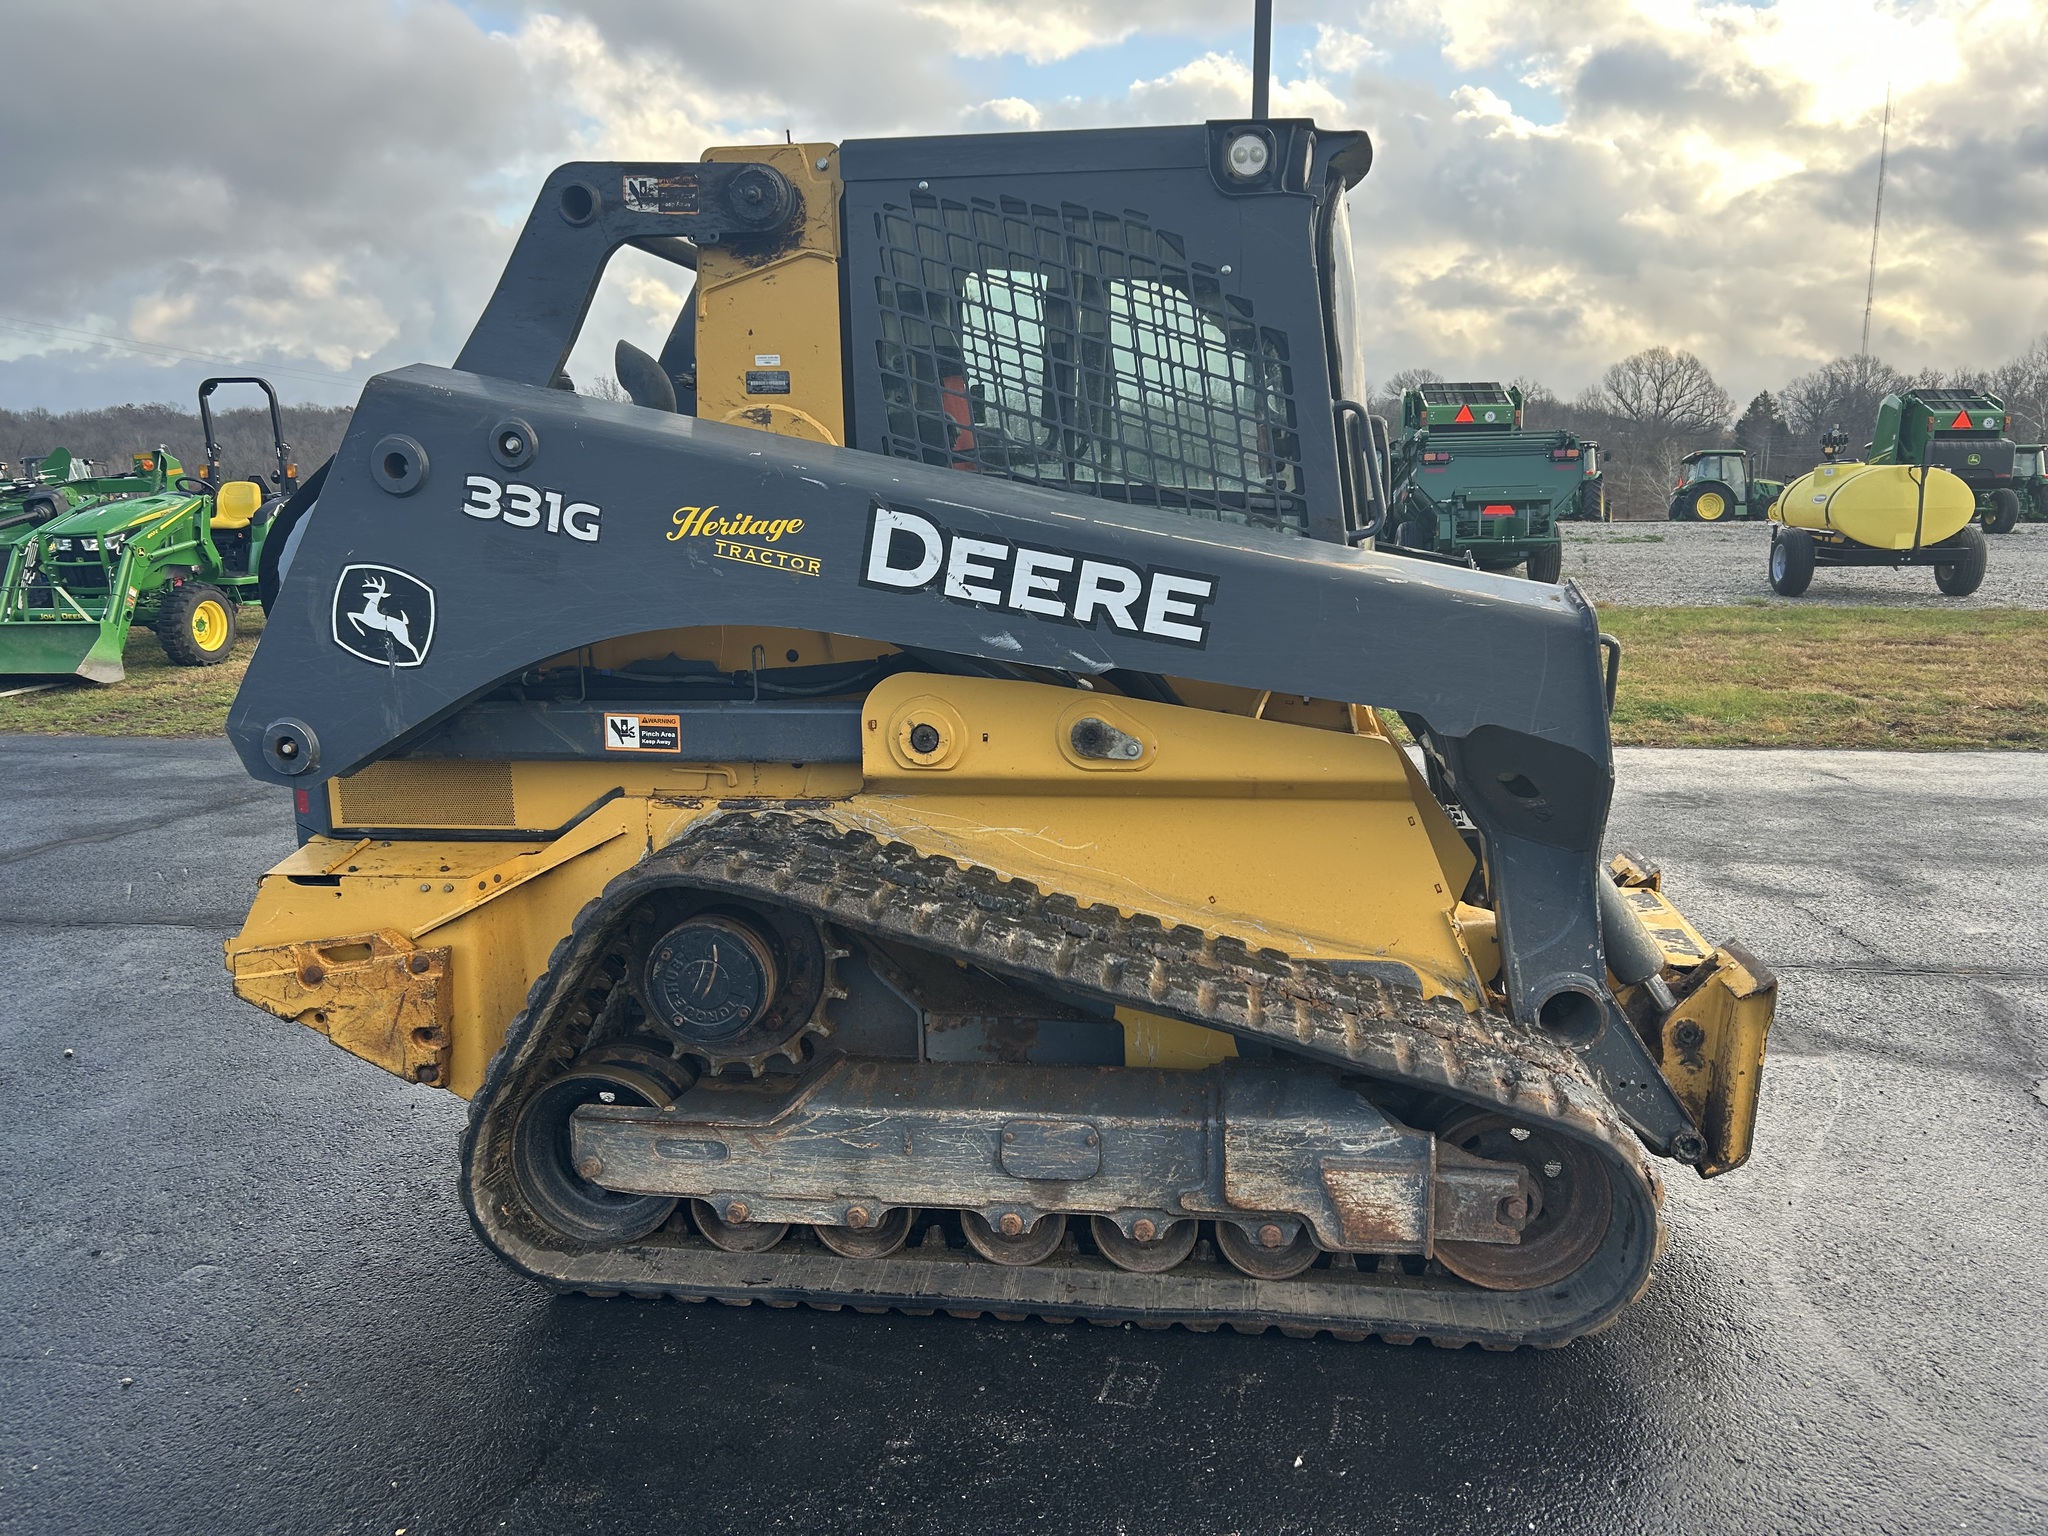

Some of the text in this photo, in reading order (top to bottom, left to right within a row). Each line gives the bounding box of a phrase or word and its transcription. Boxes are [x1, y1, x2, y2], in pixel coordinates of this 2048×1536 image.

[462, 475, 601, 542] 331G
[665, 505, 805, 542] Heritage
[716, 542, 821, 574] TRACTOR
[867, 508, 1212, 642] DEERE
[61, 612, 85, 620] DEER
[647, 717, 676, 725] WARNING
